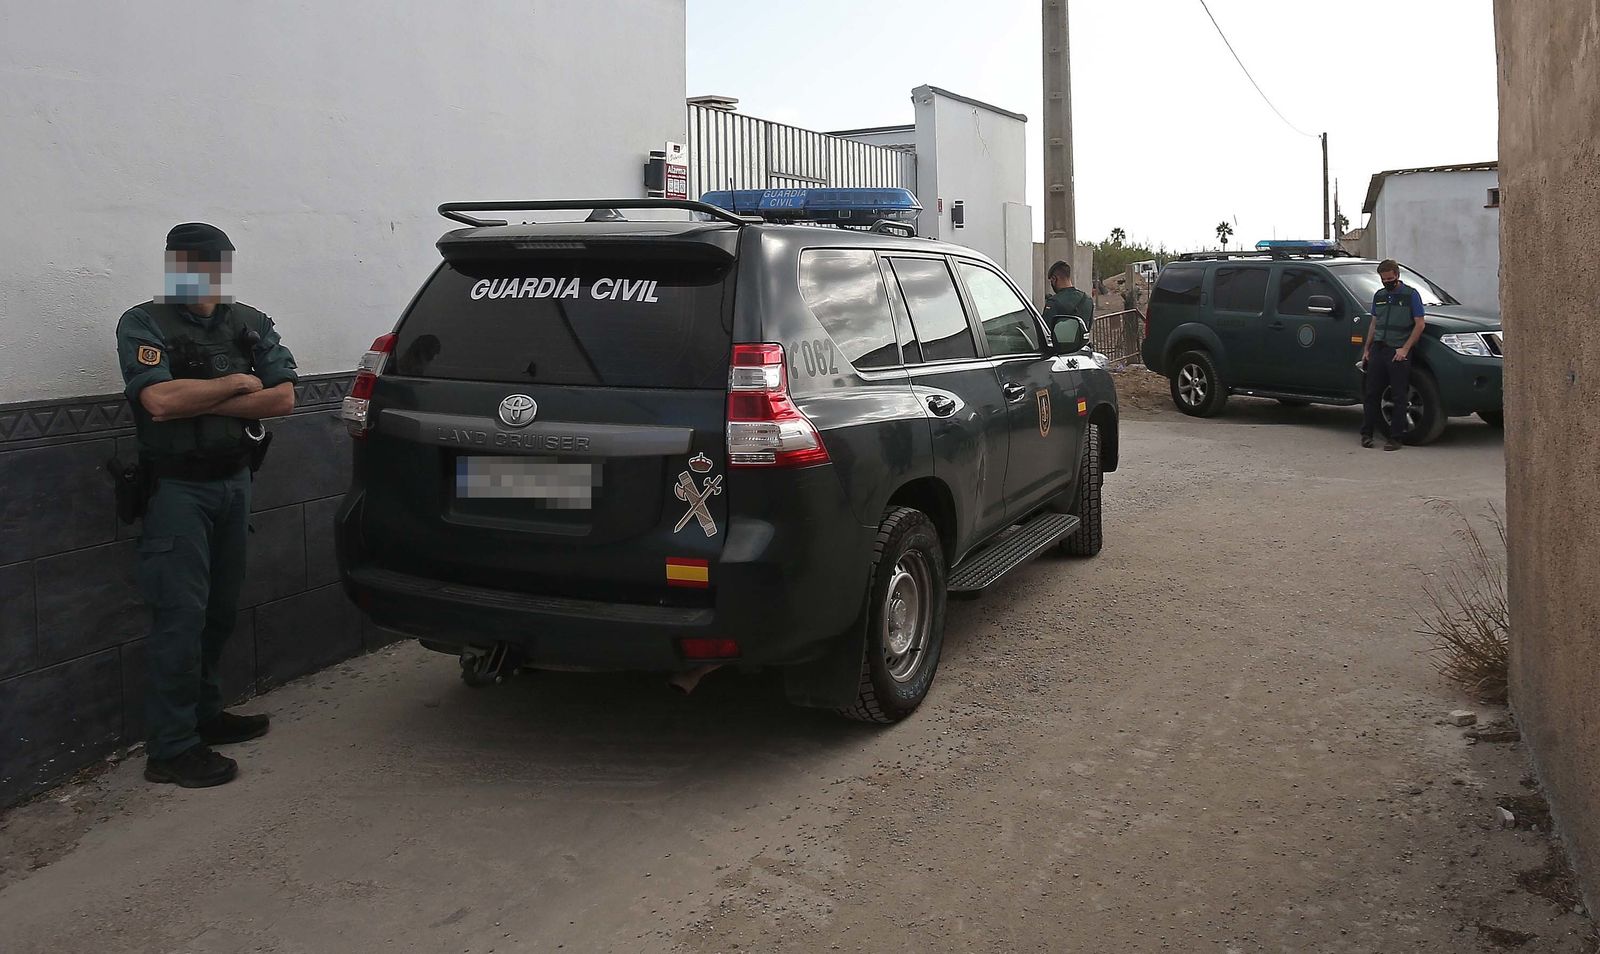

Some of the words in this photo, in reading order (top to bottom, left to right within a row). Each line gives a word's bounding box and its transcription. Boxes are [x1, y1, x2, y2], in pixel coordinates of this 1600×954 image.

[763, 189, 807, 198] GUARDIA
[769, 198, 794, 207] CIVIL
[470, 277, 581, 300] GUARDIA
[590, 277, 660, 303] CIVIL
[801, 338, 839, 377] 062
[437, 426, 487, 444] LAND
[495, 432, 590, 450] CRUISER
